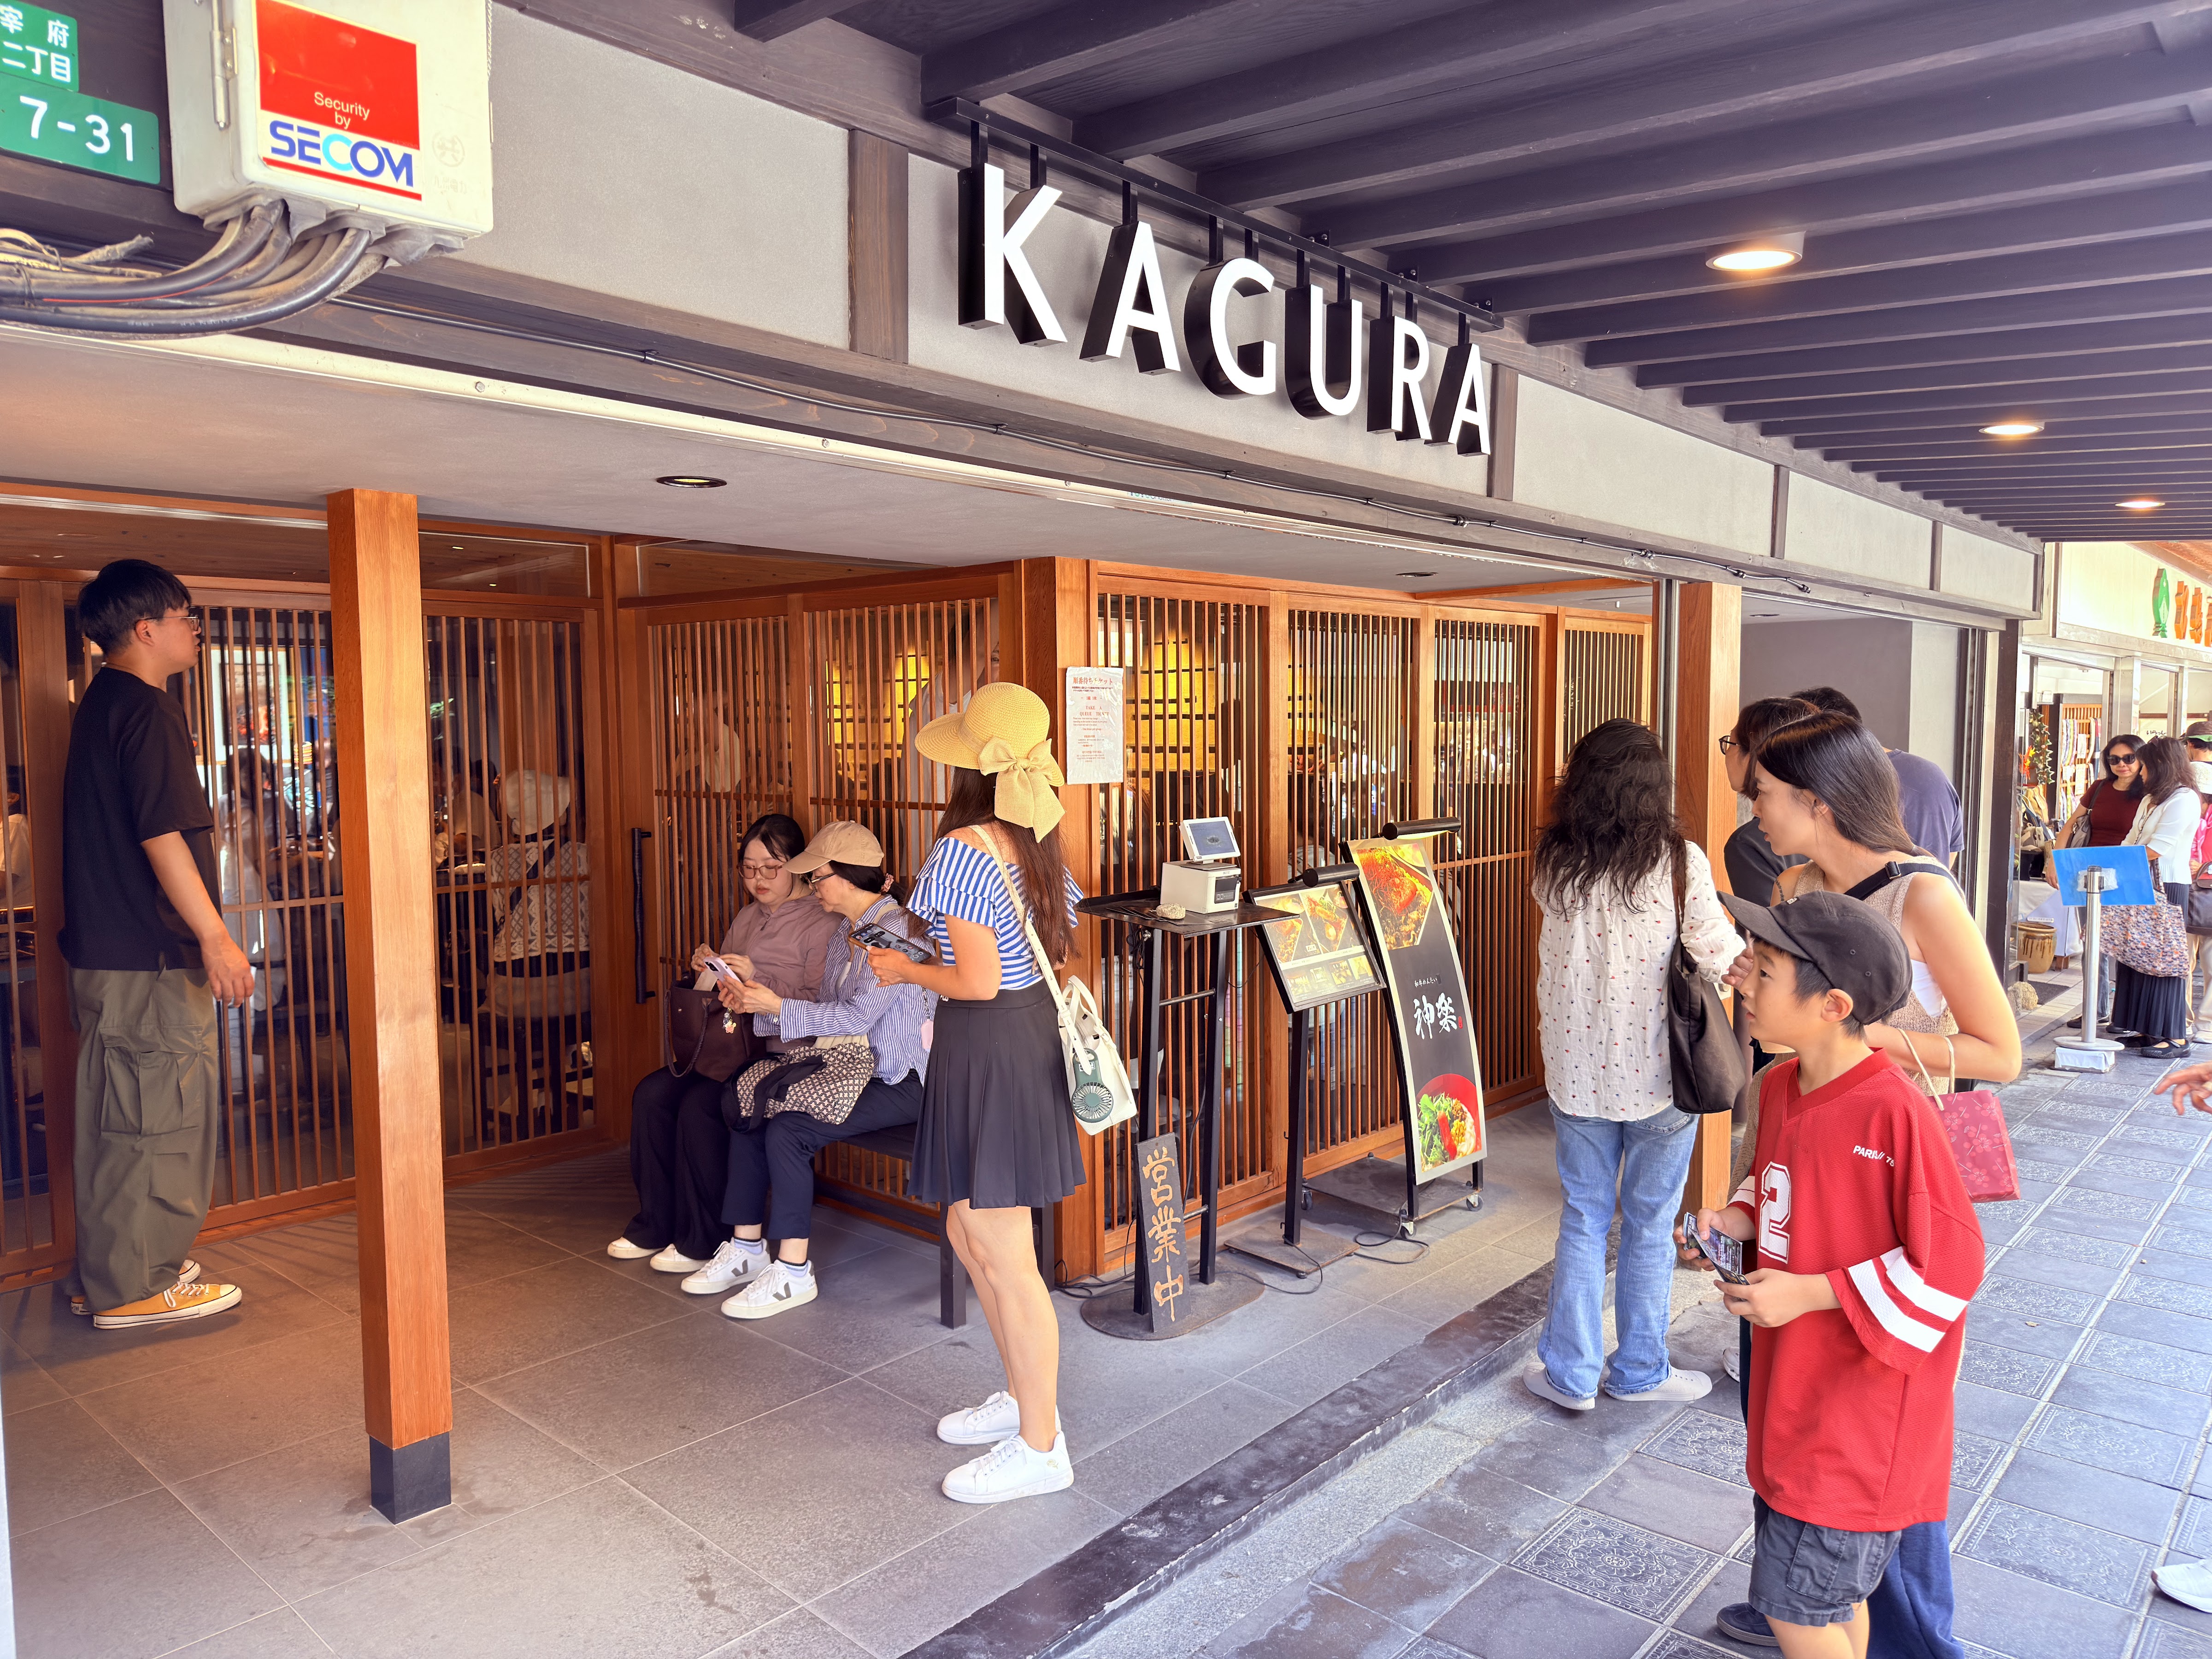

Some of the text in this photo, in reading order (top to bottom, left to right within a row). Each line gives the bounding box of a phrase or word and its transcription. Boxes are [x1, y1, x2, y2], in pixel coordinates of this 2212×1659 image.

[2, 41, 71, 83] 二丁目
[20, 95, 134, 162] 7-31
[314, 91, 370, 121] Security
[335, 111, 351, 129] by
[269, 120, 413, 188] SECOM
[977, 161, 1491, 456] KAGURA
[1073, 677, 1112, 685] 順番待ちチケット
[1414, 977, 1437, 988] 和牛めんたい
[1413, 992, 1458, 1040] 神楽
[1142, 1146, 1183, 1322] 営業中
